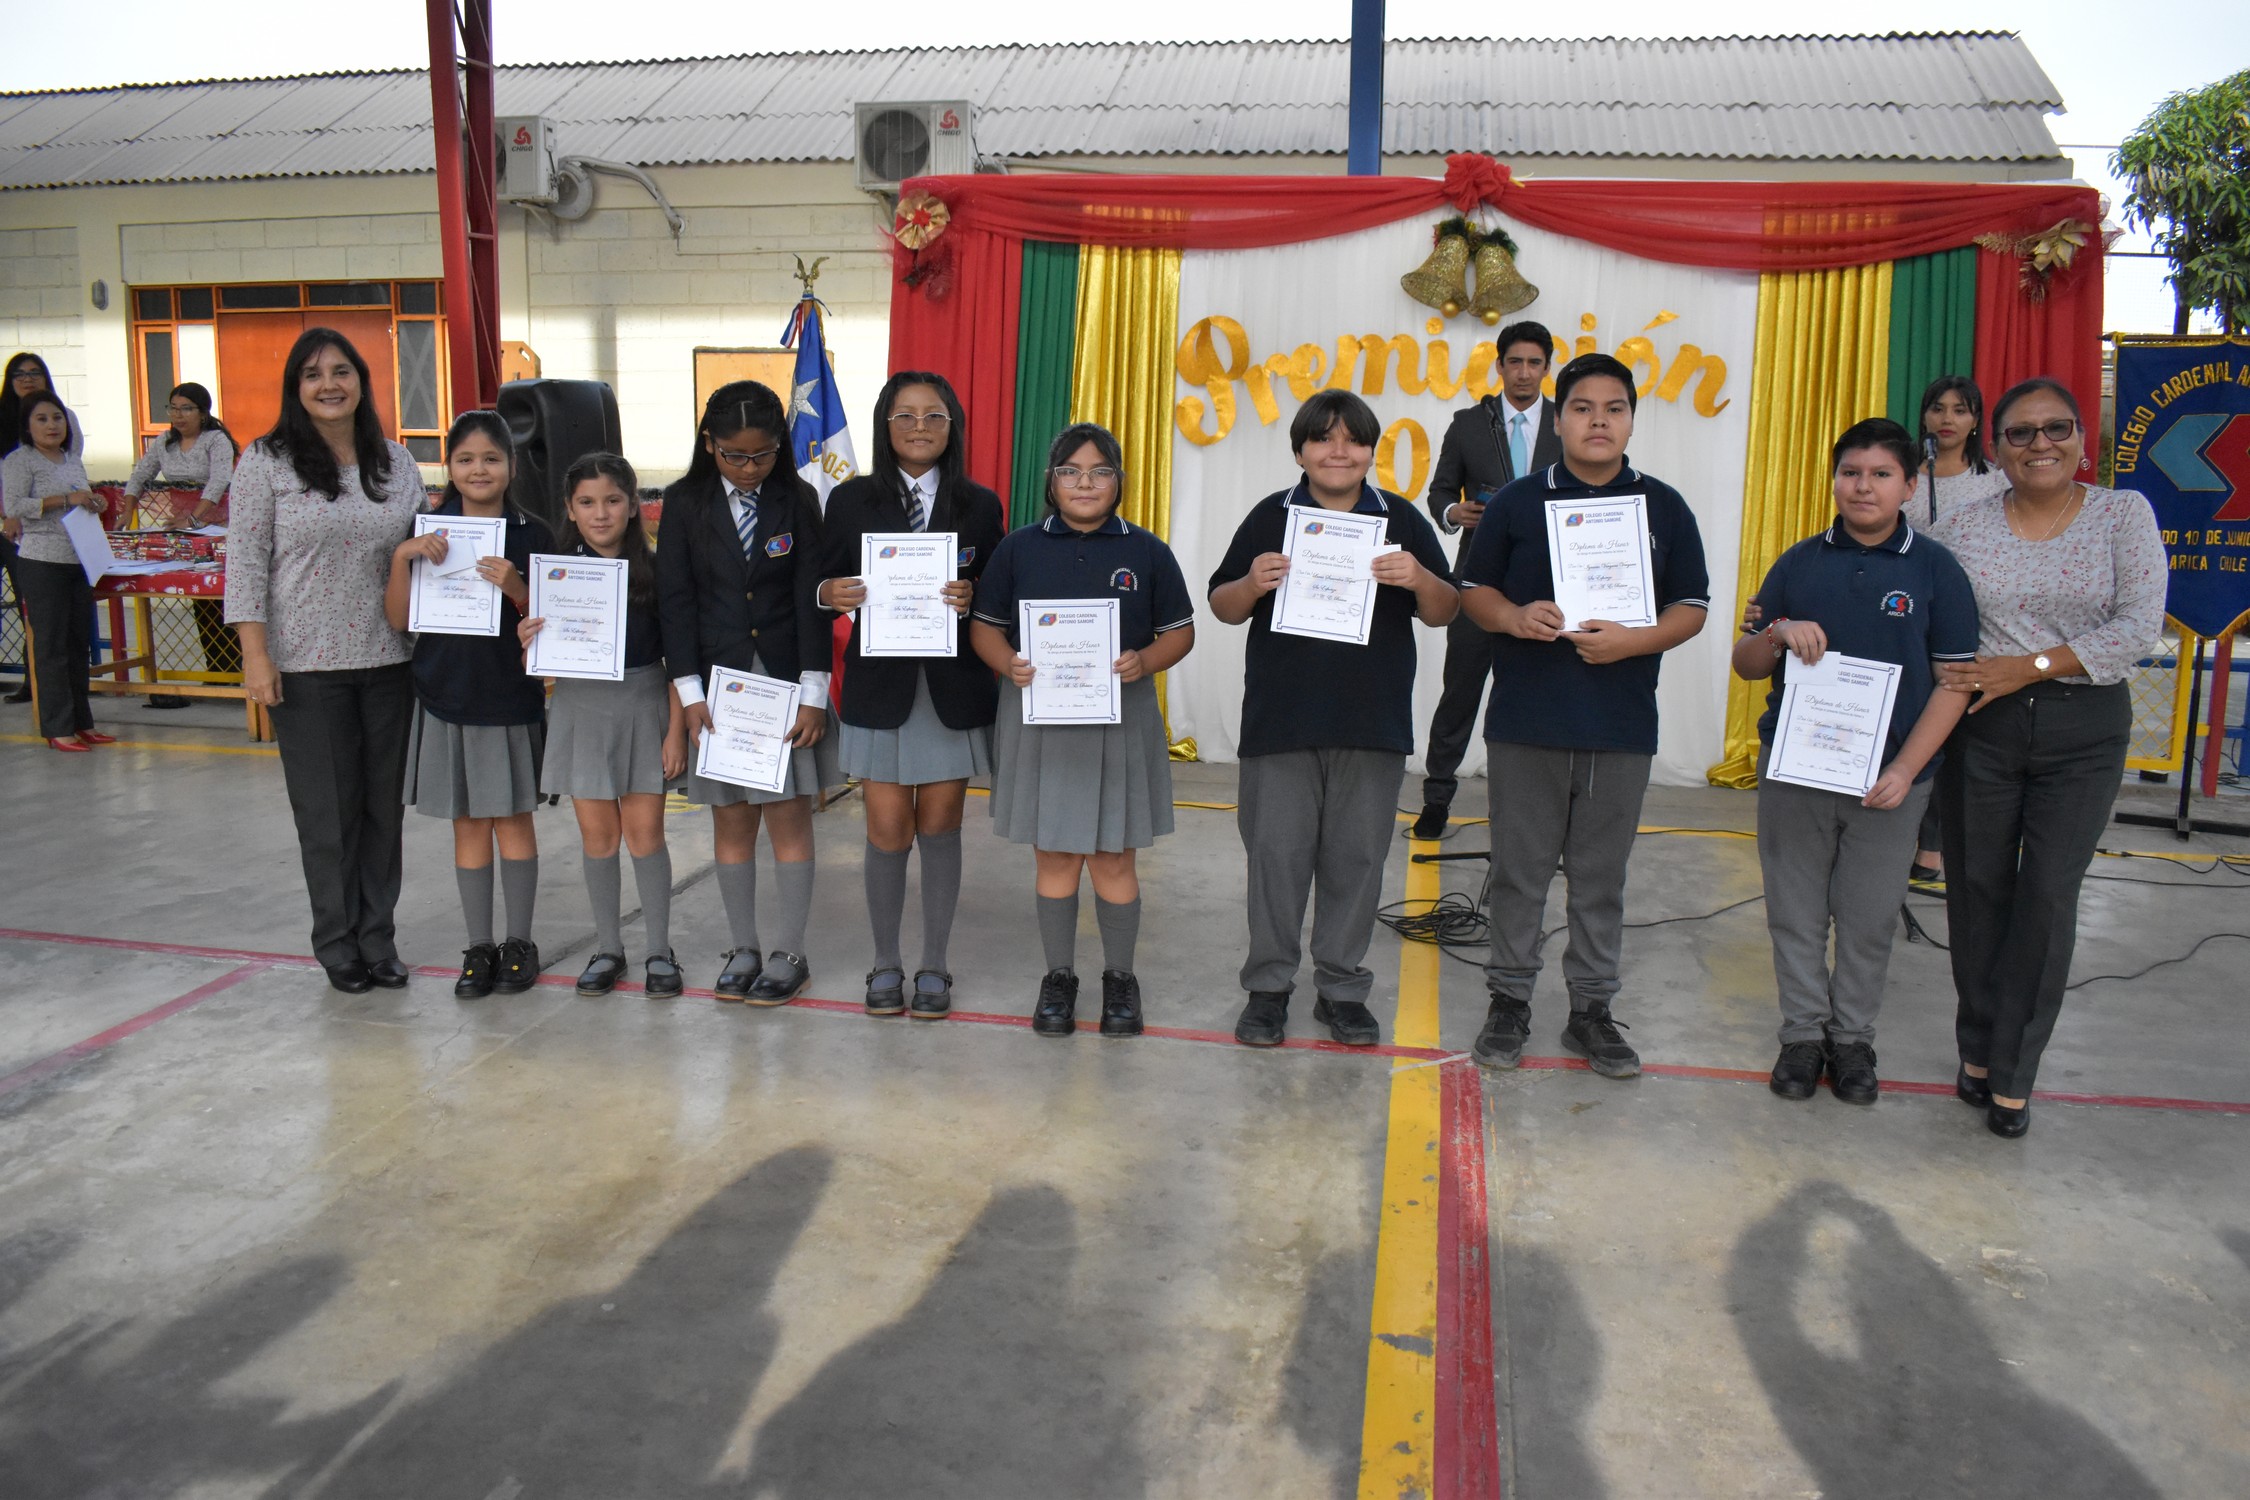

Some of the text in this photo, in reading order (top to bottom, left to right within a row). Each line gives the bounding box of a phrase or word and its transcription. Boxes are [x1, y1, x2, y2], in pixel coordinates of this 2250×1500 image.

[2115, 405, 2156, 473] COLEGIO
[2150, 361, 2233, 408] CARDENAL
[2184, 530, 2200, 545] 10
[2205, 530, 2222, 545] DE
[2169, 554, 2247, 572] ARICA CHILE
